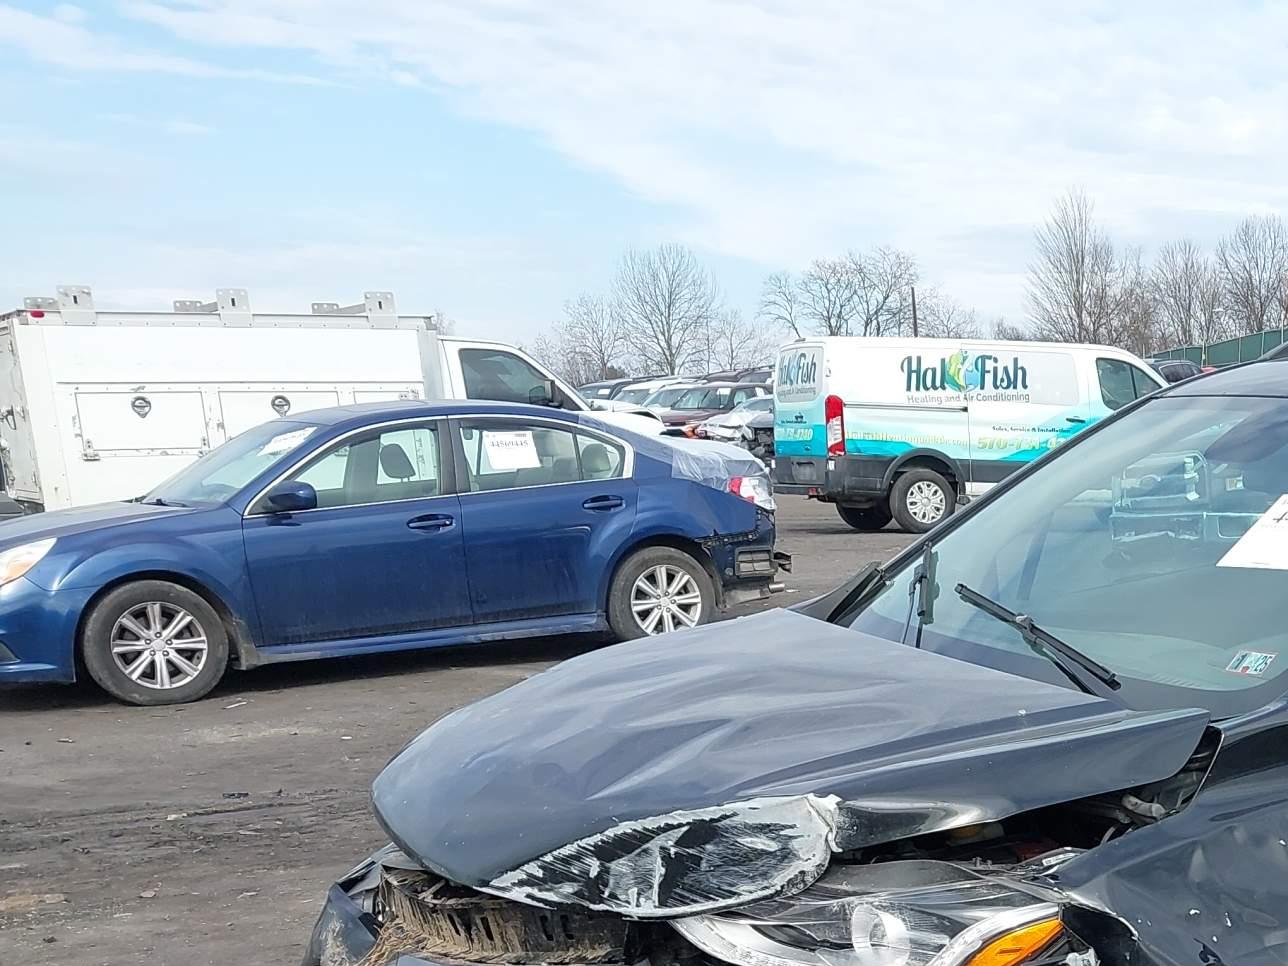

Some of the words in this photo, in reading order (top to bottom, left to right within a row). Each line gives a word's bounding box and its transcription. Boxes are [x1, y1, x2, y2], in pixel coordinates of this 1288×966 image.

[974, 354, 1028, 391] Fish
[906, 394, 943, 405] Heating
[945, 394, 961, 403] and
[963, 393, 974, 402] Air
[975, 392, 1030, 403] Conditioning
